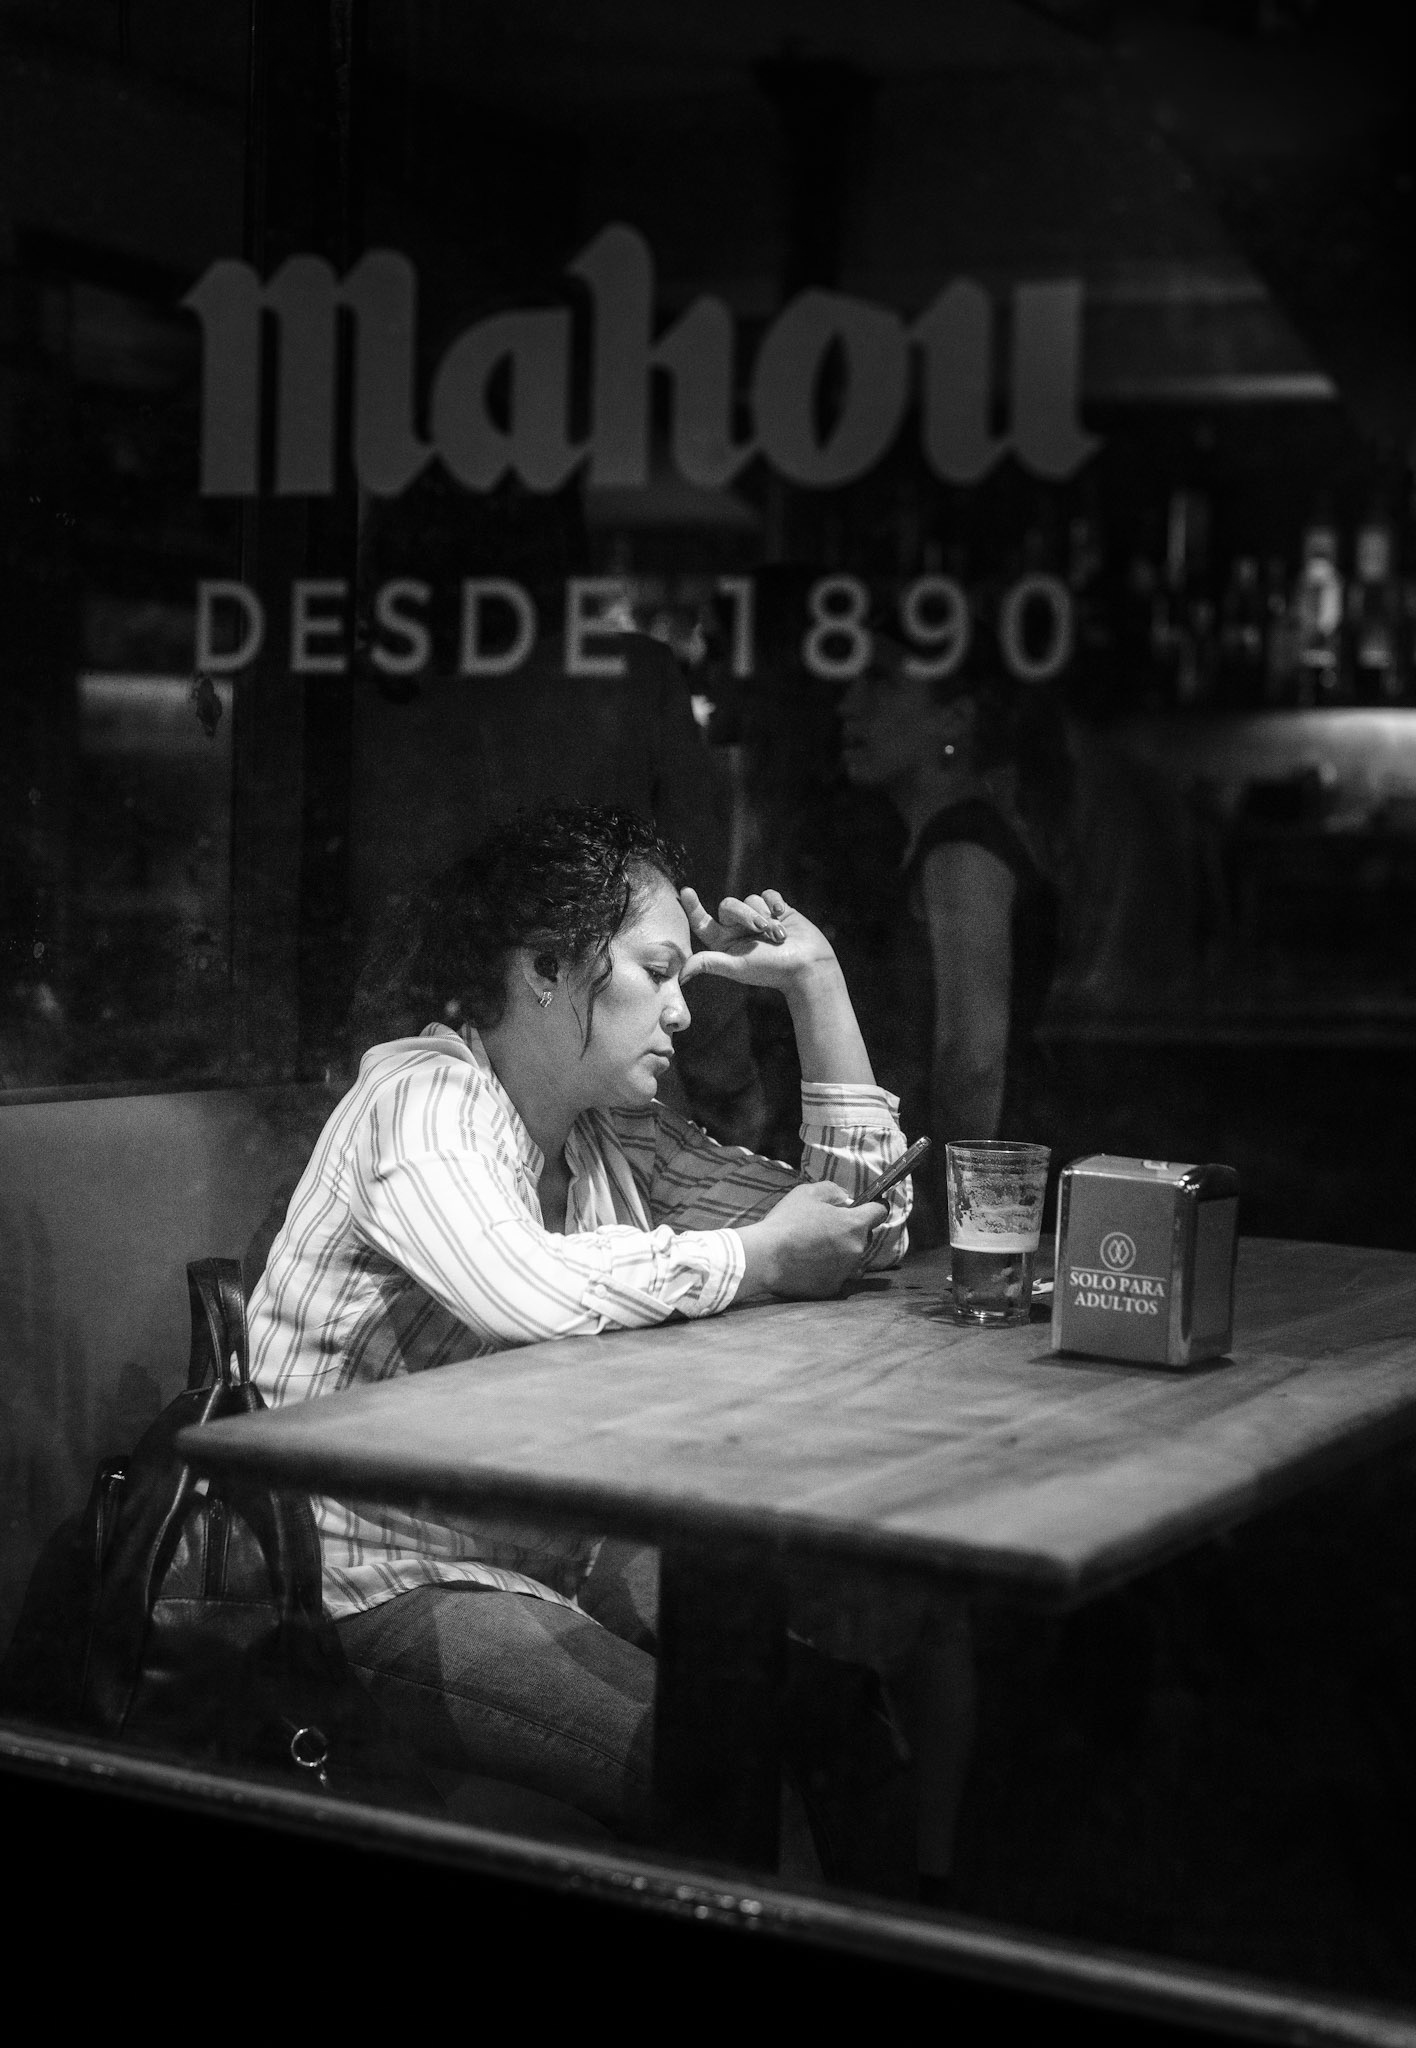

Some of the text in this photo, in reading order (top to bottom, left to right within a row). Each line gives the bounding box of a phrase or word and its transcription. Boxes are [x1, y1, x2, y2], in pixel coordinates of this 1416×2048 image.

[195, 573, 1076, 681] DESDE 1890
[1069, 1271, 1165, 1297] SOLO PARA
[1073, 1291, 1159, 1315] ADULTOS
